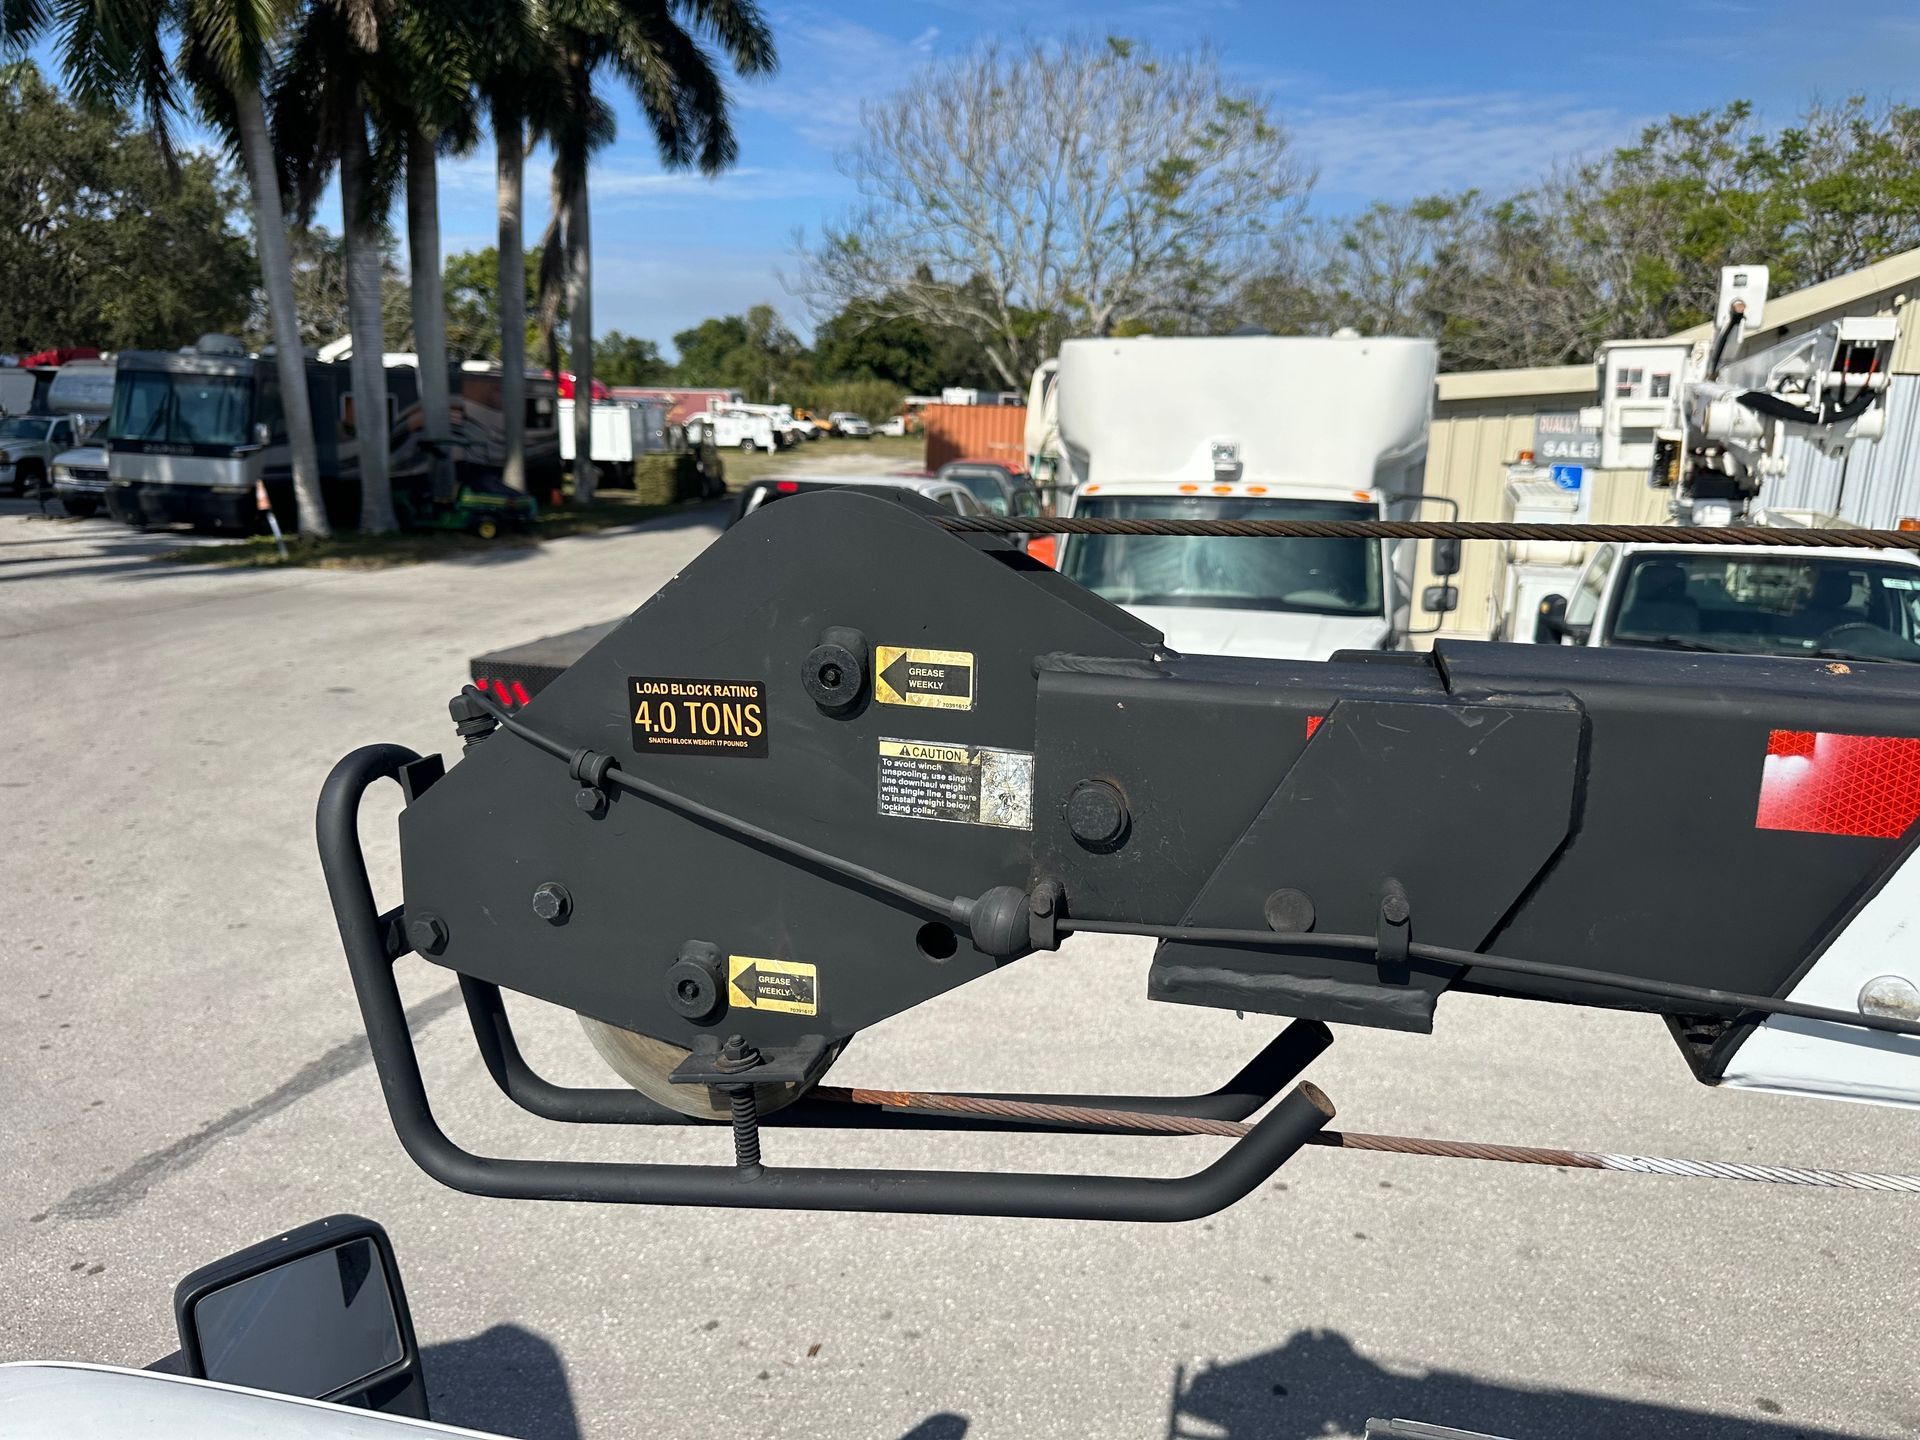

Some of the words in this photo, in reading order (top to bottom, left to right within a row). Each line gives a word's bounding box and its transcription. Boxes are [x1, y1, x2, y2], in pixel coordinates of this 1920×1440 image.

[908, 668, 945, 678] GREASE
[636, 682, 668, 694] LOAD
[671, 683, 712, 696] BLOCK
[714, 685, 758, 698] RATING
[908, 680, 944, 690] WEEKLY
[634, 700, 677, 733] 4.0
[683, 701, 763, 737] TONS
[648, 736, 672, 744] SNATCH
[723, 740, 749, 748] POUNDS
[912, 747, 962, 761] CAUTION
[882, 758, 892, 766] To
[894, 760, 916, 768] avoid
[918, 762, 942, 771] winch
[882, 769, 929, 780] unspooling,
[948, 775, 973, 784] single
[882, 776, 896, 784] line
[898, 778, 937, 788] downhaul
[939, 782, 966, 792] weight
[882, 786, 898, 794] with
[900, 787, 924, 796] single
[926, 790, 944, 798] line.
[946, 792, 957, 800] Be
[958, 794, 977, 802] sure
[881, 803, 910, 813] locking
[891, 794, 916, 804] install
[918, 798, 945, 807] weight
[946, 801, 970, 811] below
[758, 976, 791, 986] GREASE
[758, 986, 790, 996] WEEKLY
